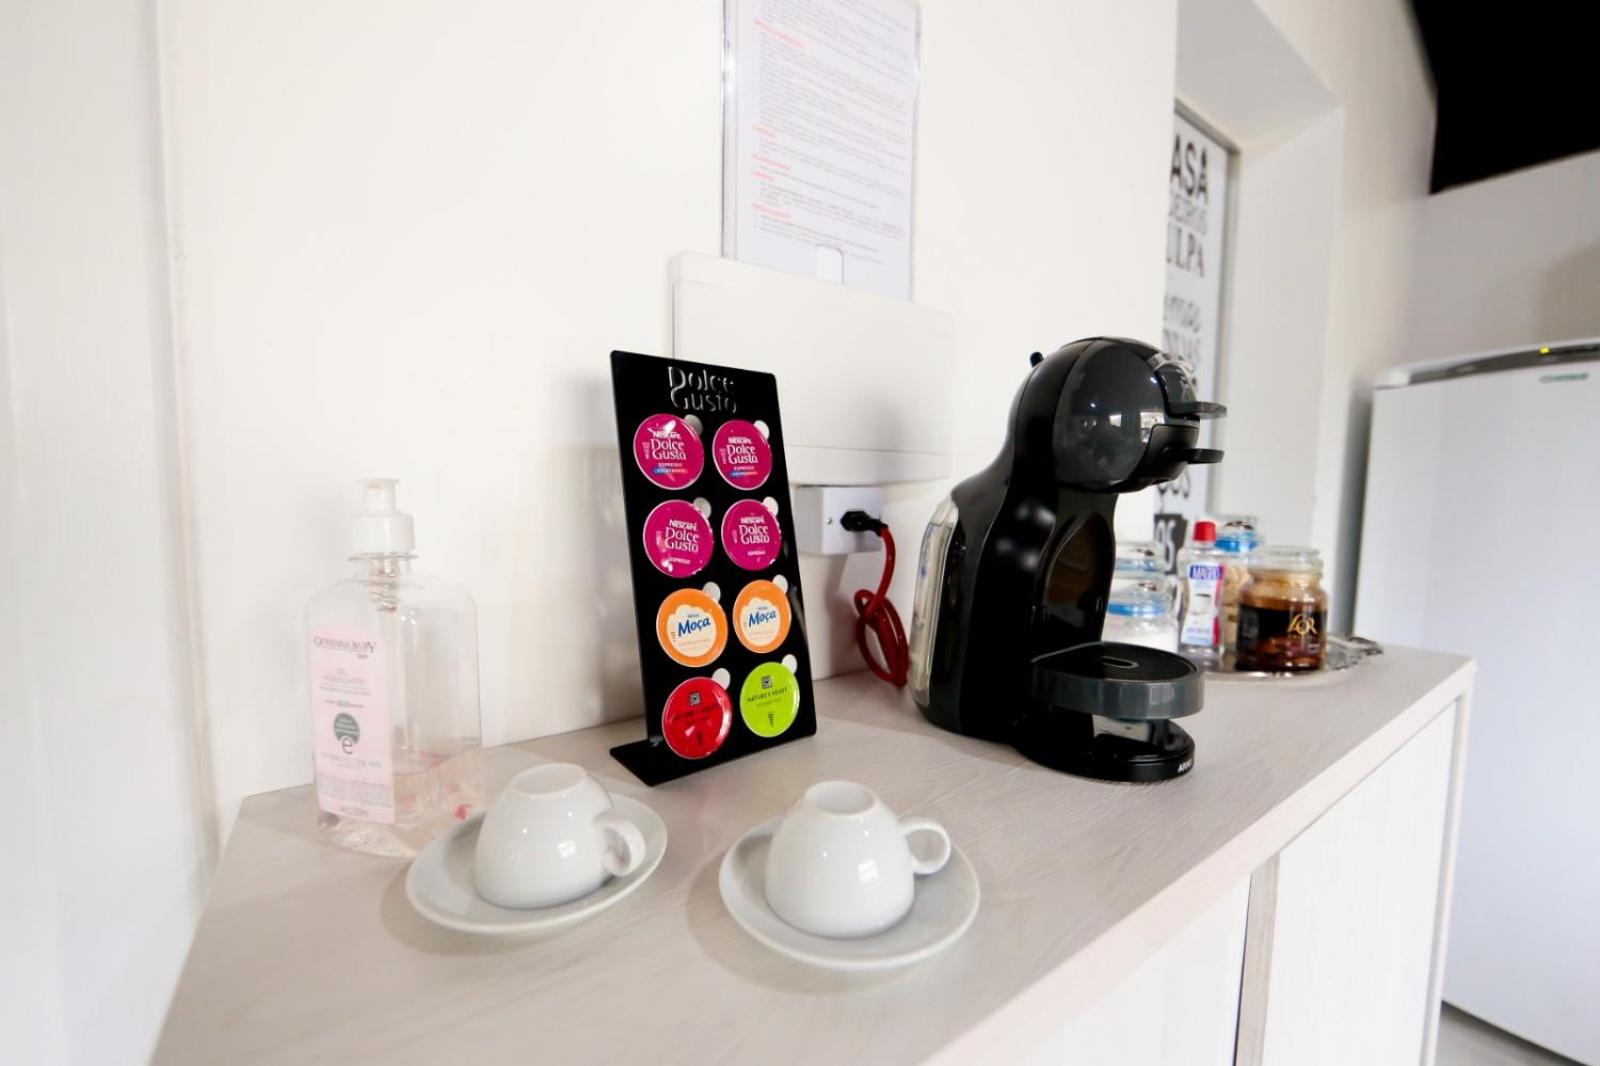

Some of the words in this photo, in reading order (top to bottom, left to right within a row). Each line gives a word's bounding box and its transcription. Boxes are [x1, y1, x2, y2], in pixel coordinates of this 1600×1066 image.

[667, 365, 735, 394] Dolce
[670, 386, 738, 414] Gusto
[650, 438, 685, 452] Dolce
[726, 443, 756, 455] Dolce
[651, 448, 688, 461] Gusto
[728, 453, 759, 465] Gusto
[665, 526, 701, 544] Dolce
[738, 522, 769, 537] Dolce
[664, 538, 700, 554] Gusto
[740, 534, 770, 545] Gusto
[748, 609, 777, 628] Moça
[677, 617, 711, 637] Moça
